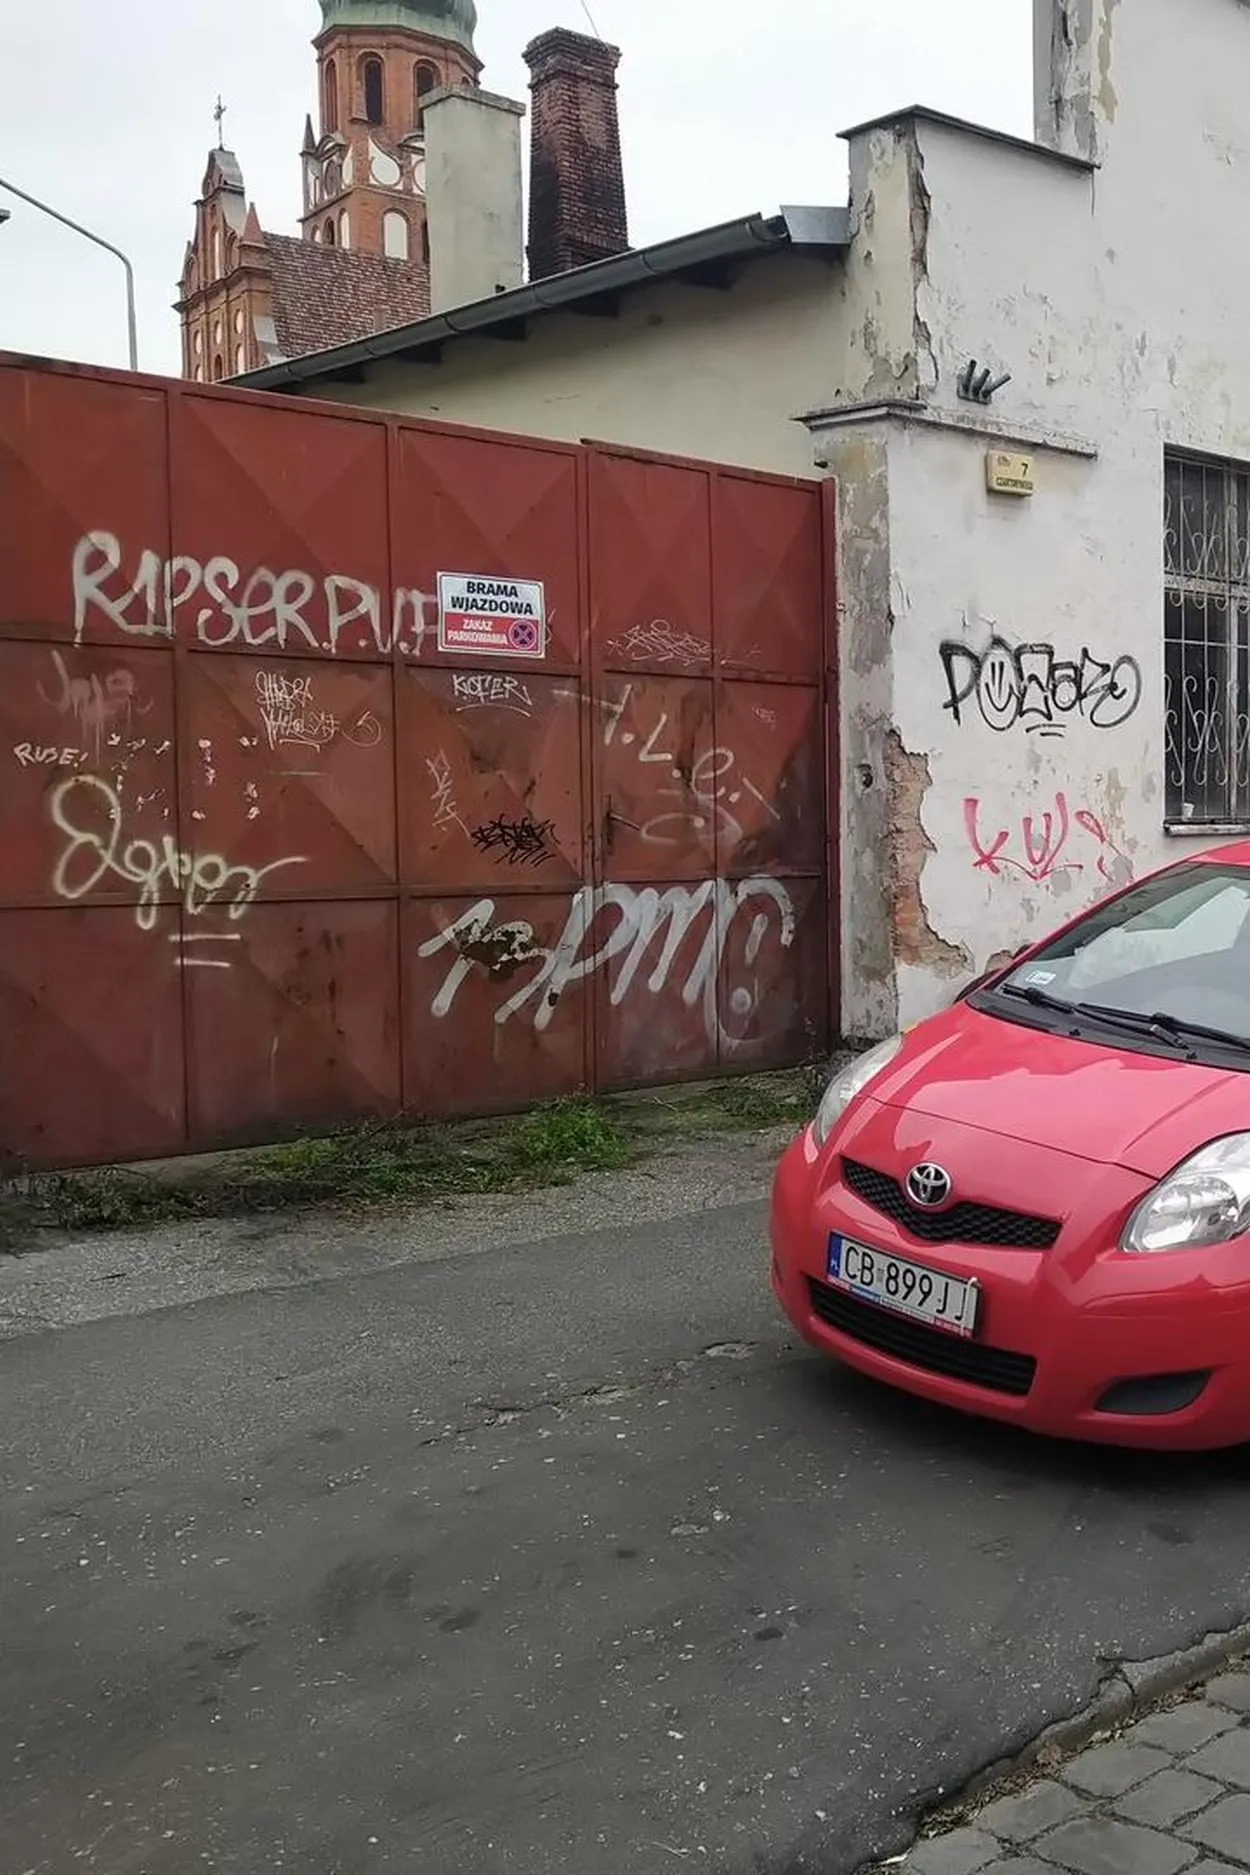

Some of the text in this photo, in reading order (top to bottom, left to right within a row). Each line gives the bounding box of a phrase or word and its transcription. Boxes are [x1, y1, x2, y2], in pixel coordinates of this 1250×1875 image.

[1020, 462, 1029, 477] 7
[466, 581, 519, 598] BRAMA
[451, 596, 533, 615] WJAZDOWA
[463, 619, 493, 631] ZAKAZ
[845, 1246, 875, 1287] CB
